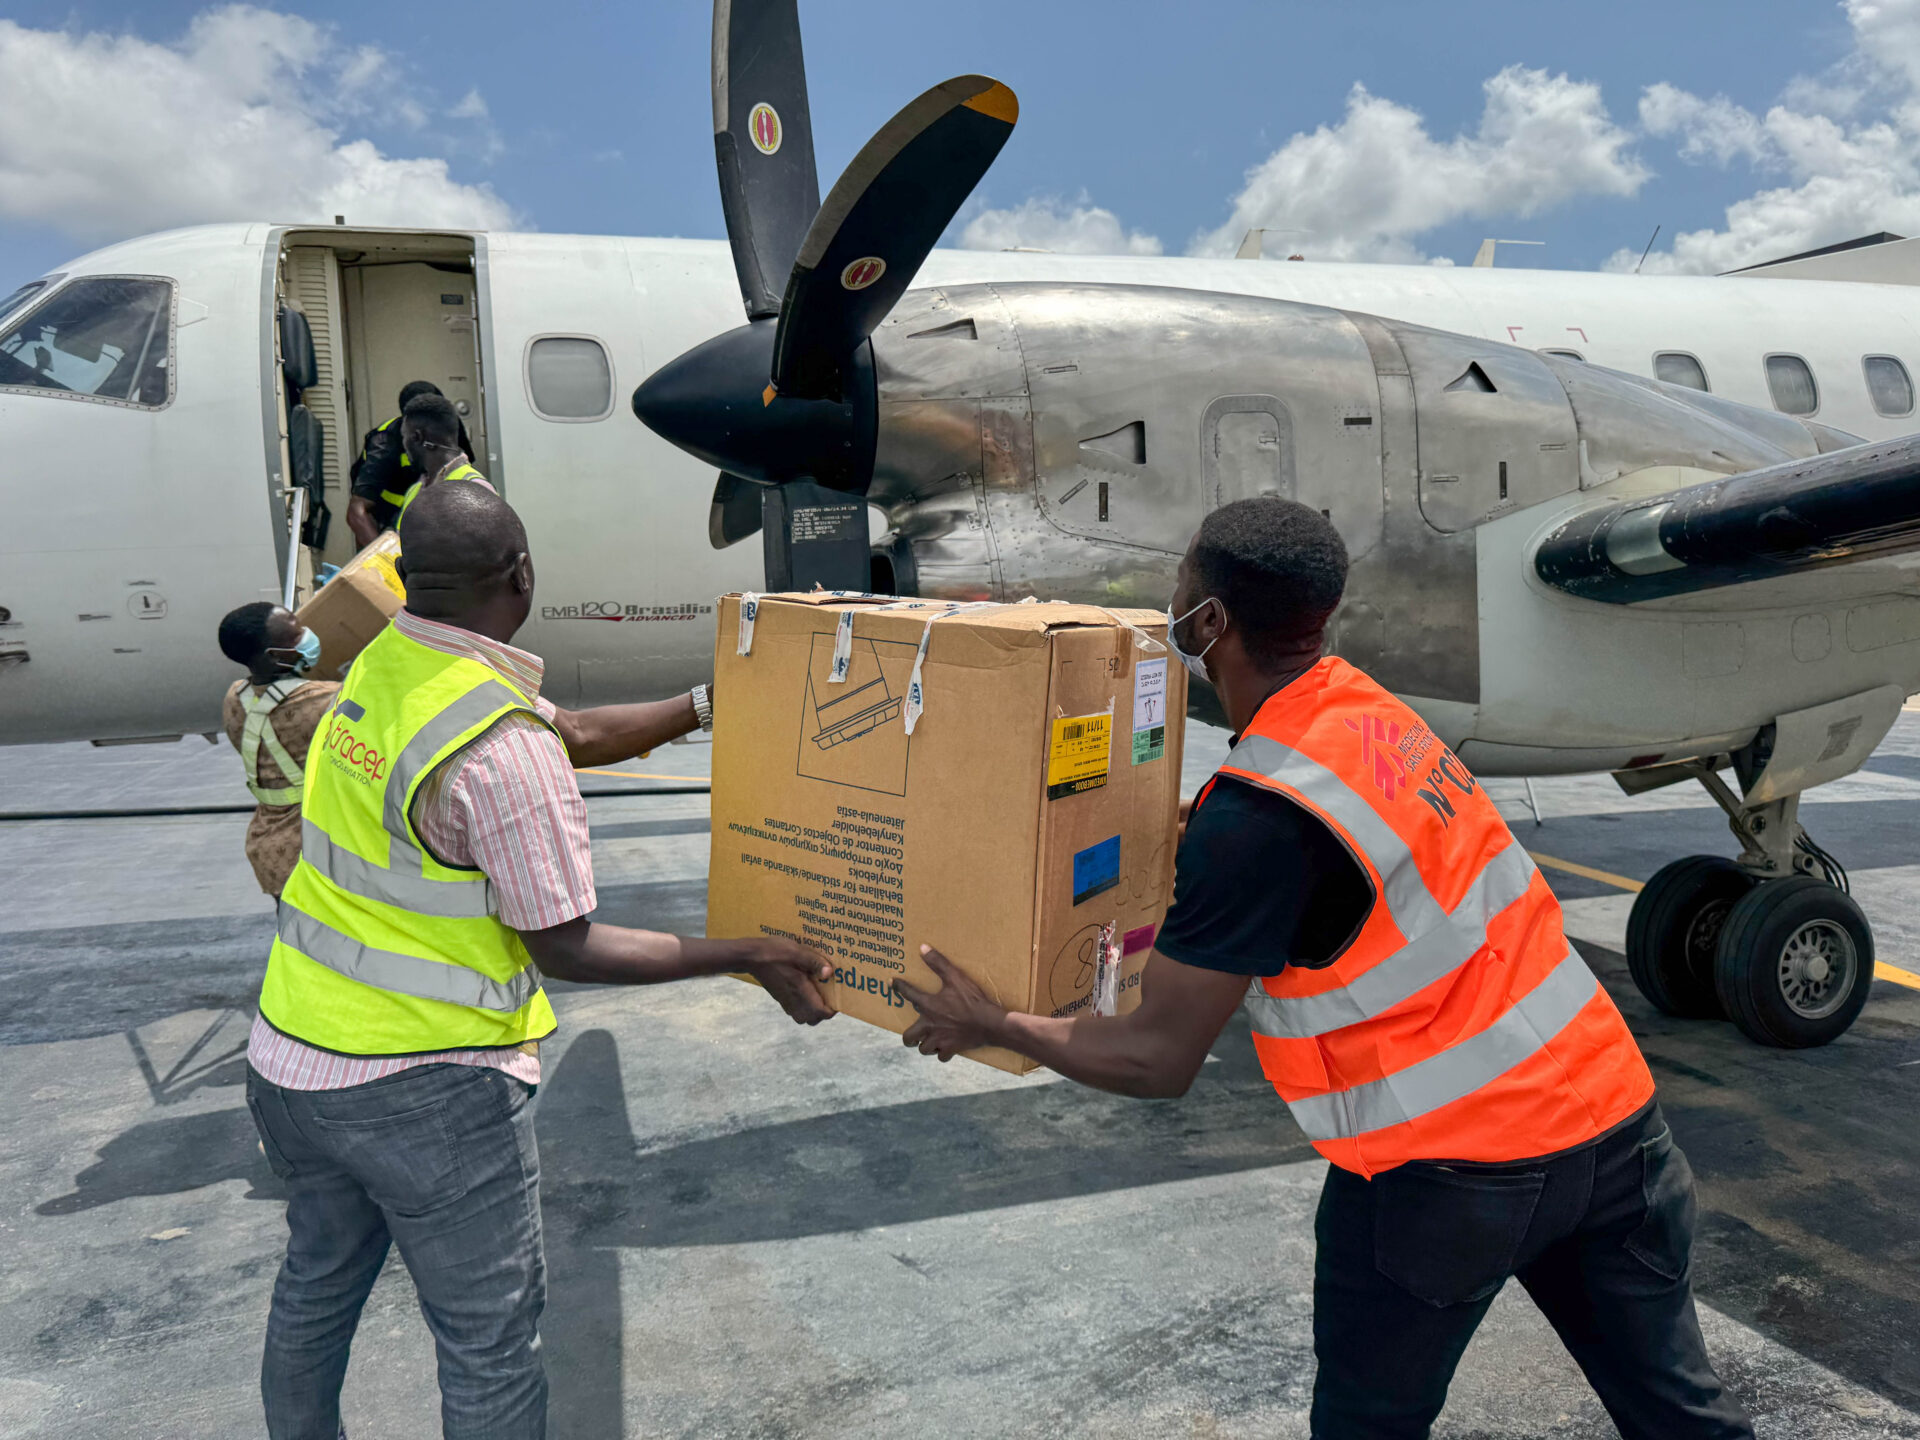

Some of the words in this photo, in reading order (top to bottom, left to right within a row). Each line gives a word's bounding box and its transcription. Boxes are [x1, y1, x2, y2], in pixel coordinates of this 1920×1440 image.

[625, 604, 711, 614] Brasilia
[1087, 720, 1103, 734] 11/11
[1398, 720, 1425, 755] MEDECINS
[329, 721, 386, 780] tracep
[1405, 749, 1425, 772] SANS
[764, 818, 801, 836] Cortantes
[836, 806, 905, 830] Jäteneula-astia
[803, 827, 840, 846] Objectos
[832, 820, 904, 845] Kanylebeholder
[843, 837, 853, 848] de
[856, 840, 903, 860] Contentor
[741, 853, 762, 866] avfall
[875, 858, 903, 875] Δοχίο
[843, 880, 856, 894] för
[848, 867, 903, 889] Kanyleboks
[859, 884, 903, 903] Behållare
[795, 896, 827, 914] taglienti
[821, 889, 903, 918] Naaldencontainer
[830, 905, 845, 916] per
[798, 910, 904, 946] Kanülenabwurfbehälter
[848, 910, 904, 932] Contenitore
[760, 925, 801, 944] Punzantes
[802, 924, 842, 944] Proximité
[844, 936, 855, 945] de
[803, 937, 834, 956] Objetos
[837, 947, 848, 957] de
[857, 939, 905, 960] Collecteur
[850, 951, 905, 974] Contenedor
[834, 967, 905, 1008] Sharps
[1127, 972, 1140, 989] BD
